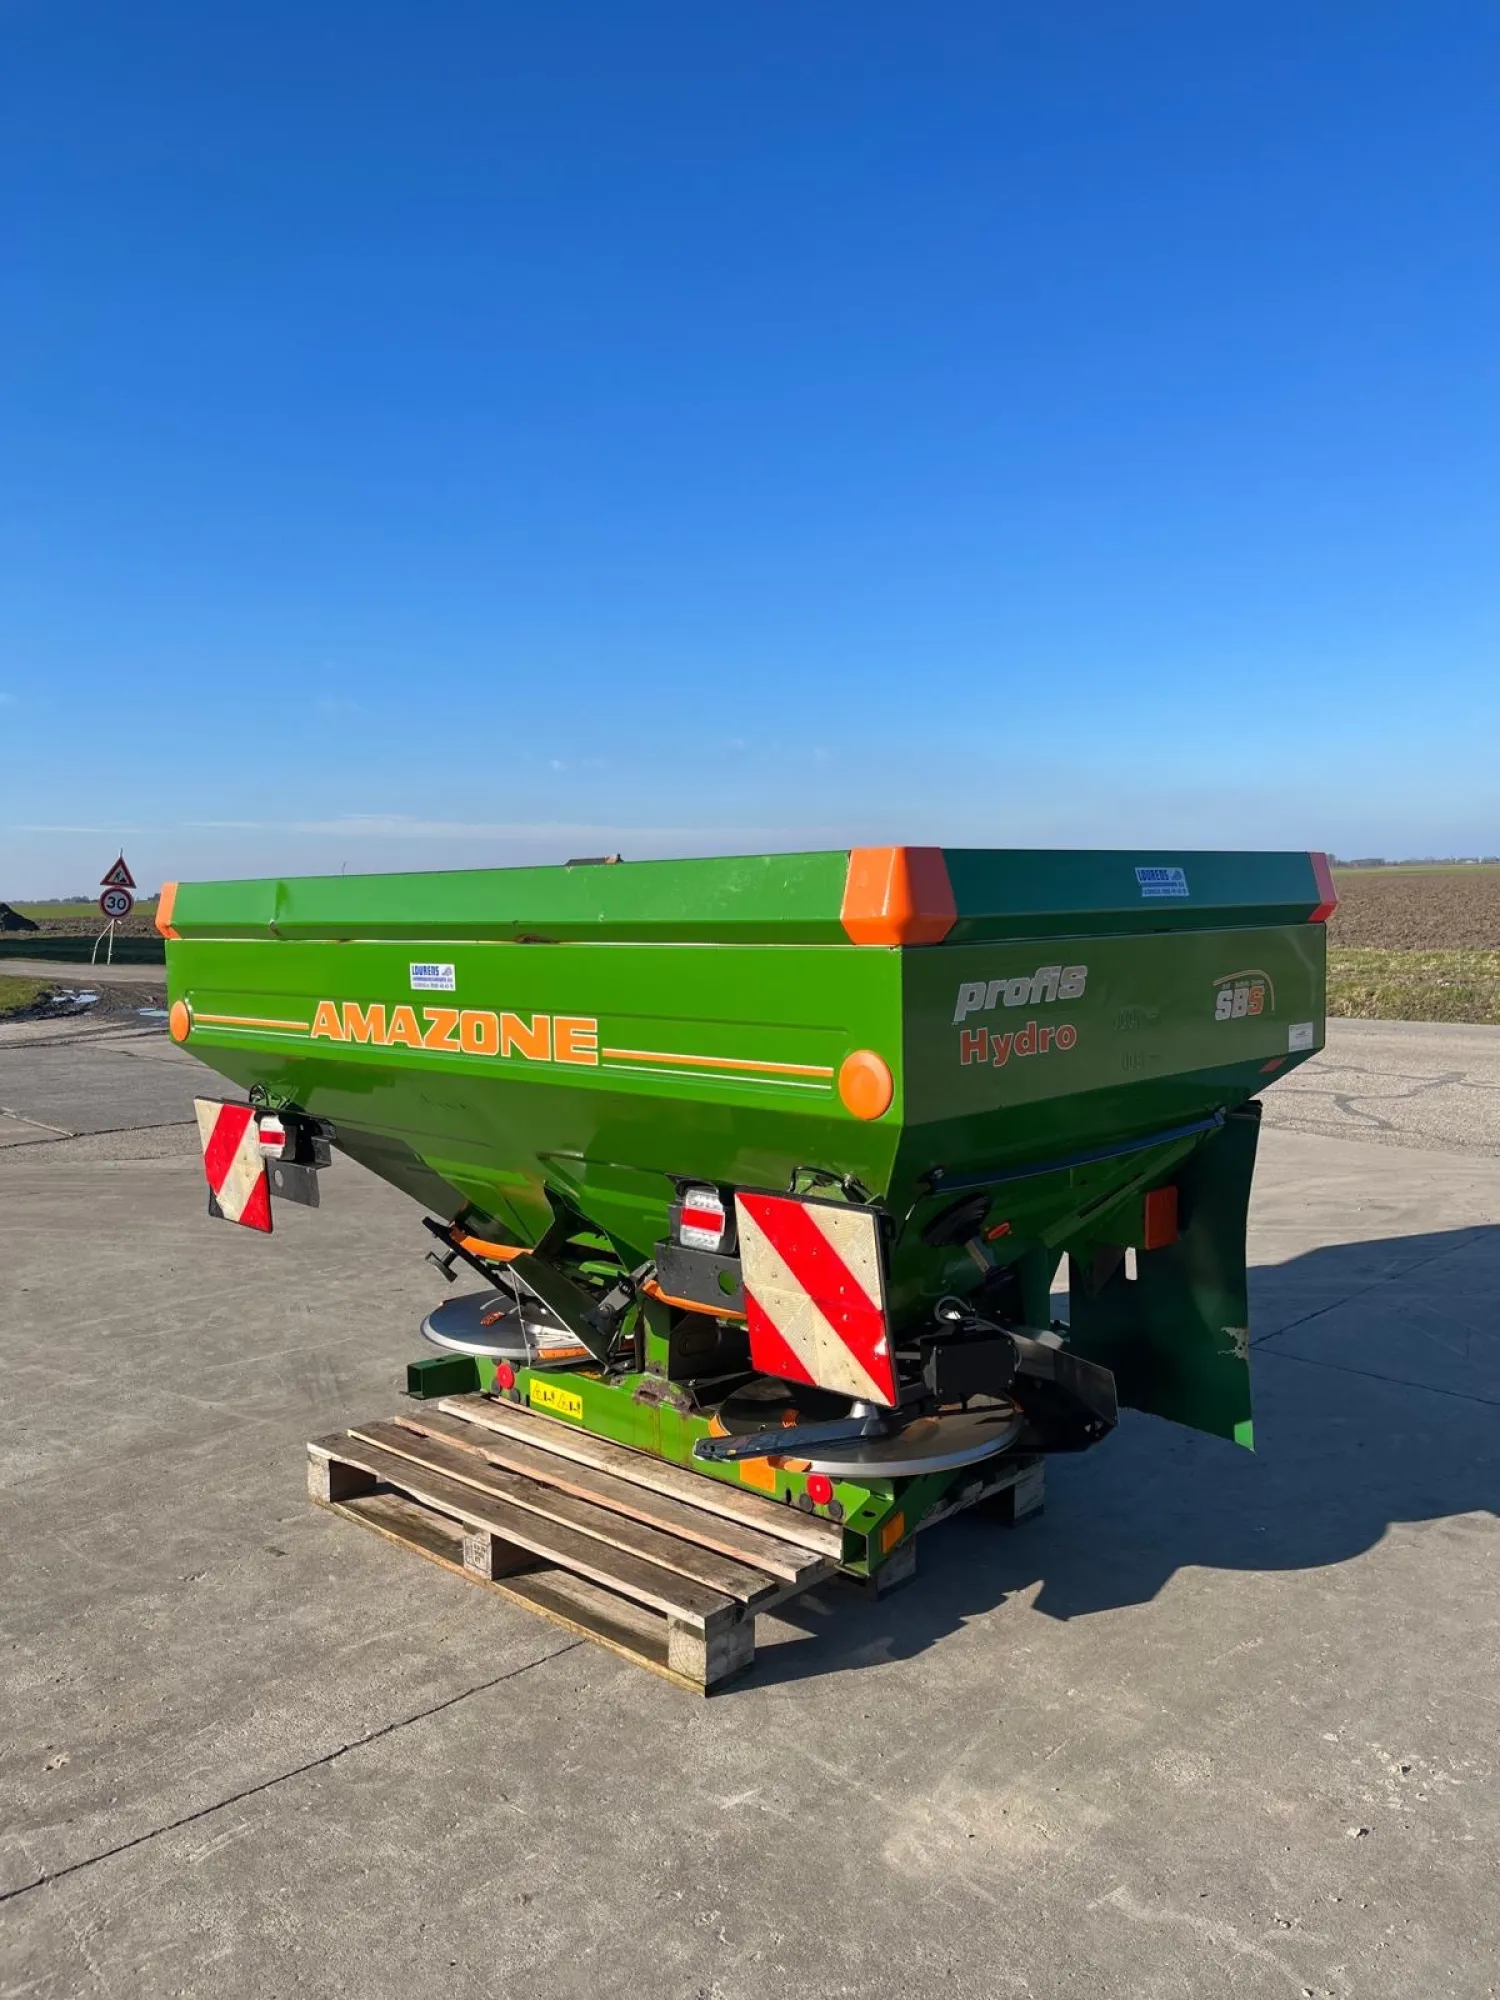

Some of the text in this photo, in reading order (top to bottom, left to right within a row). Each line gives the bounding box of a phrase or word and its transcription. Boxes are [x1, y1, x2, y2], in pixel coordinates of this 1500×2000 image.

[106, 896, 127, 910] 30
[953, 965, 1088, 1022] profis
[1214, 985, 1265, 1021] SBS
[310, 1000, 599, 1066] AMAZONE
[960, 1020, 1077, 1067] Hydro
